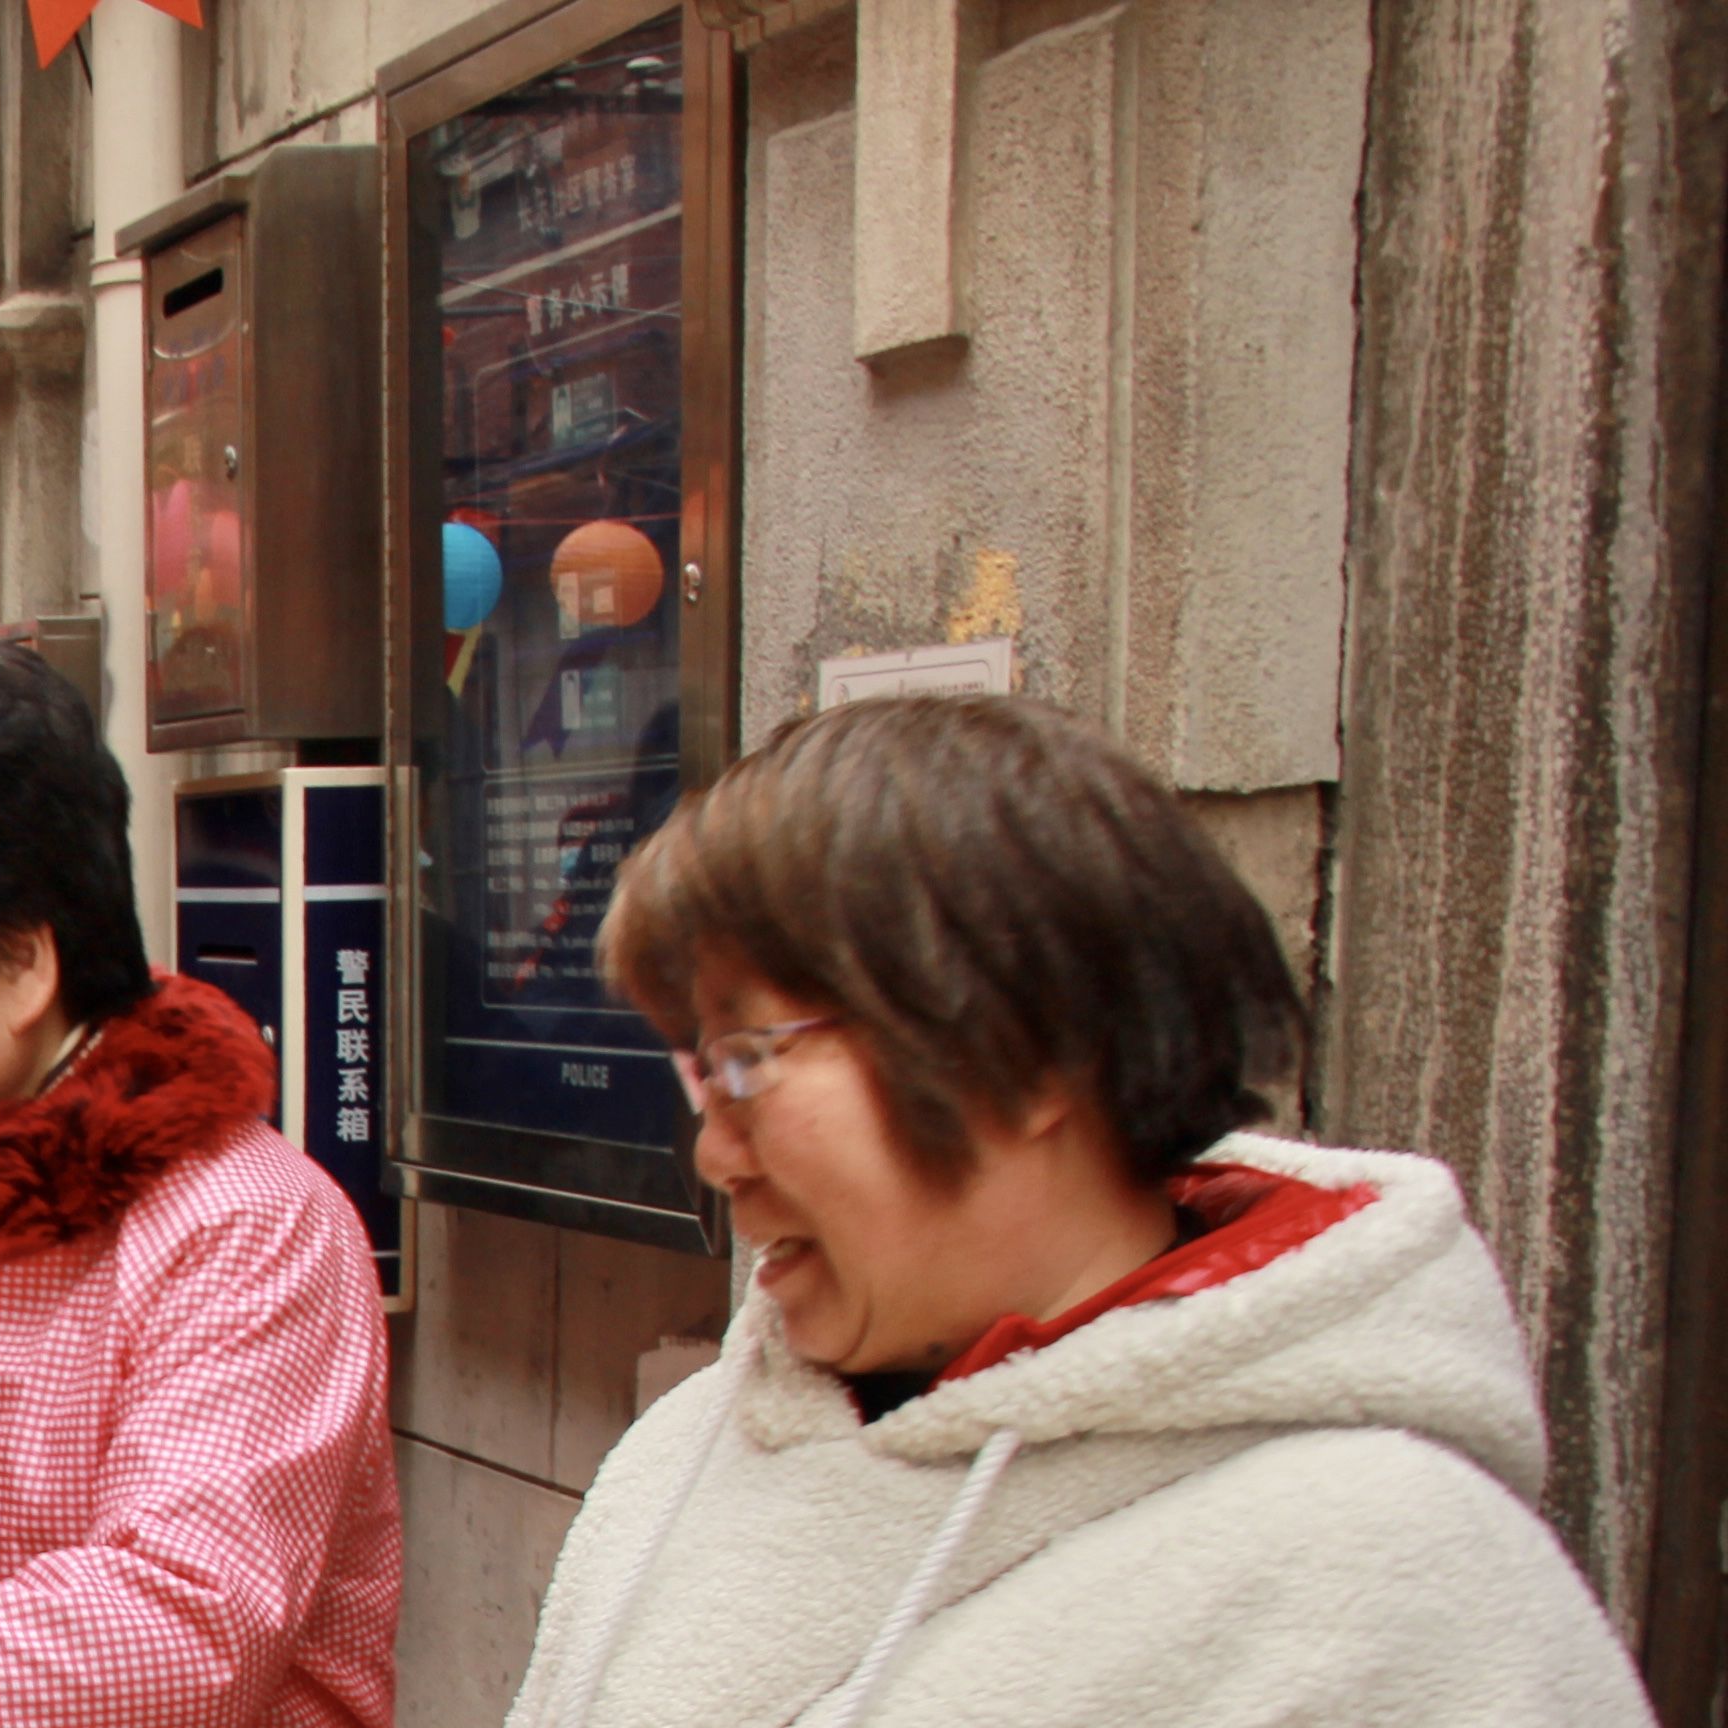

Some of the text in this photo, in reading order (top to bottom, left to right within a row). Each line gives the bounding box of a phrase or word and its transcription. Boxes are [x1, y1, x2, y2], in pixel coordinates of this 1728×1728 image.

[336, 949, 370, 1143] 警民联系箱
[561, 1062, 610, 1089] POLICE
